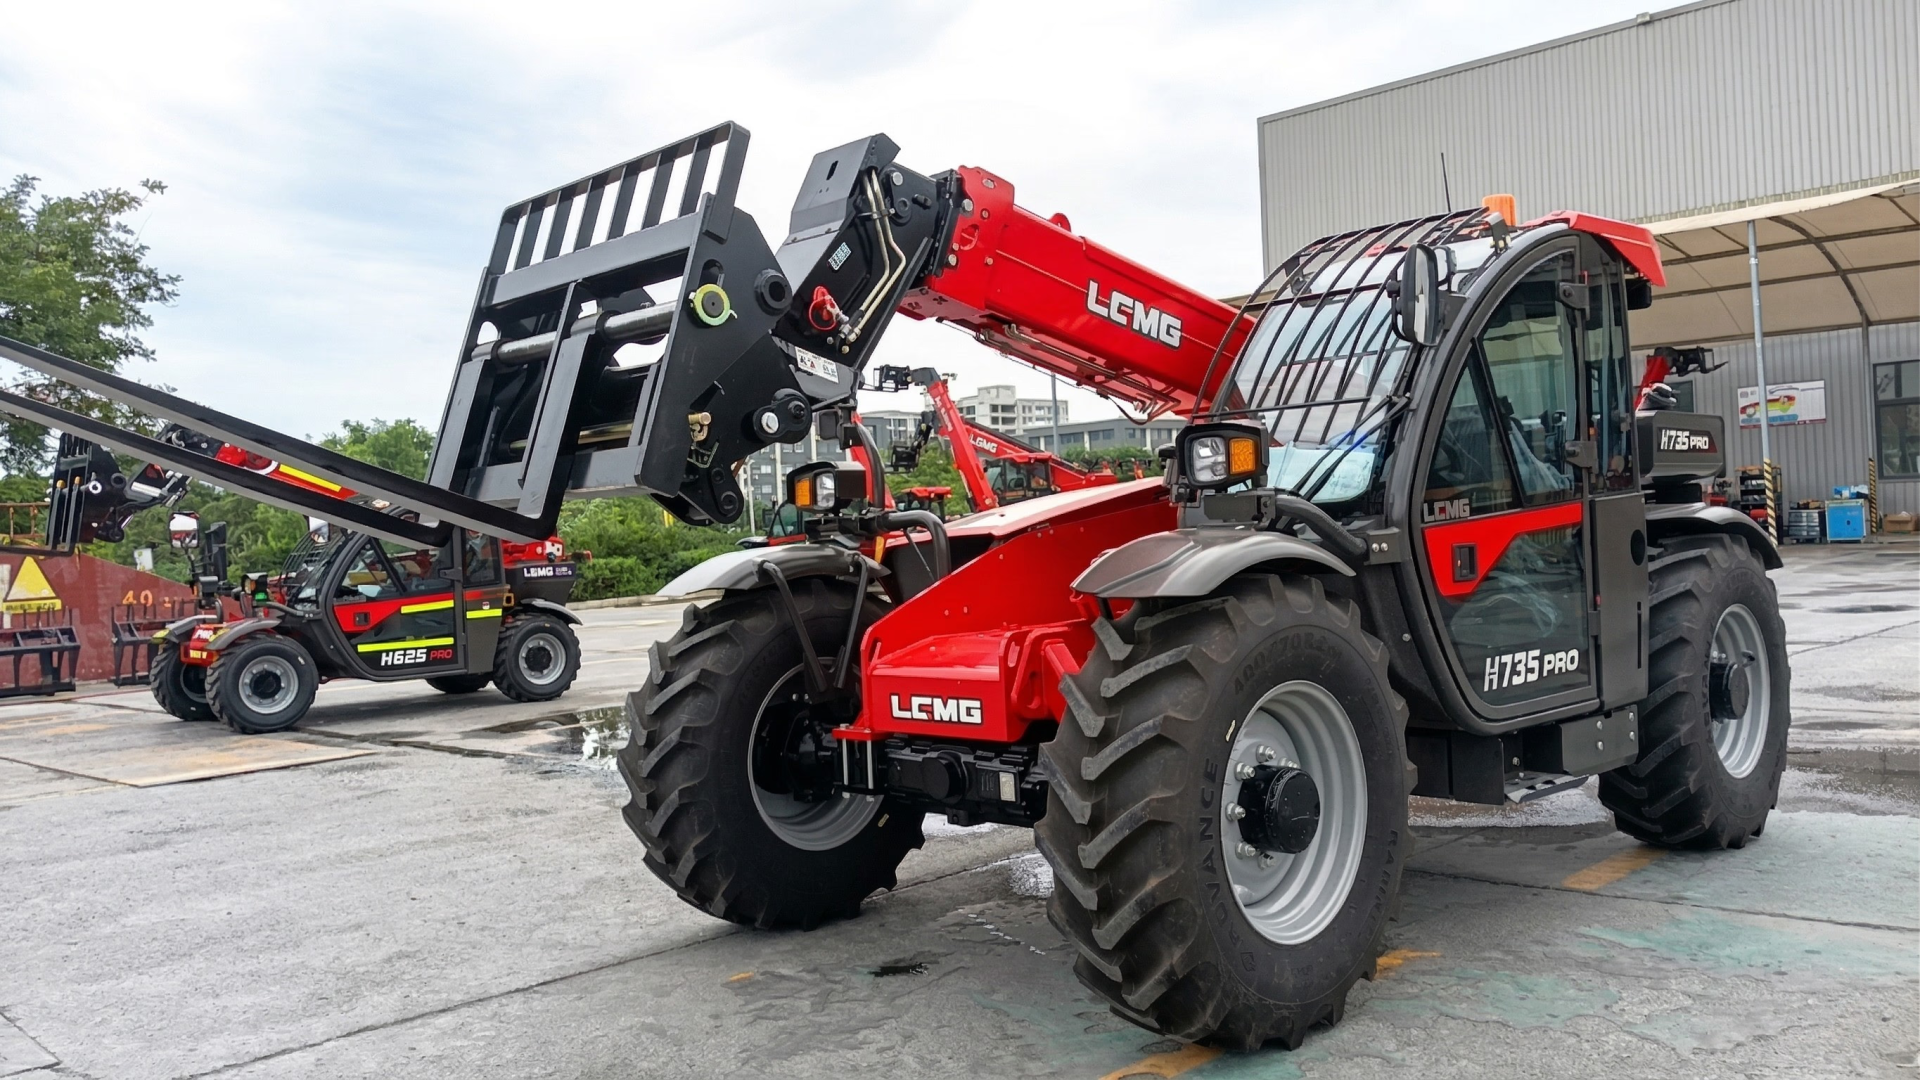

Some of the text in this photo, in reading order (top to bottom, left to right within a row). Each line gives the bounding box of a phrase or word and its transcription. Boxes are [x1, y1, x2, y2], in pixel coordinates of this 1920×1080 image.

[1660, 429, 1709, 451] H735 PRO
[380, 648, 453, 667] H625 PRO
[1483, 648, 1580, 692] H735 PRO
